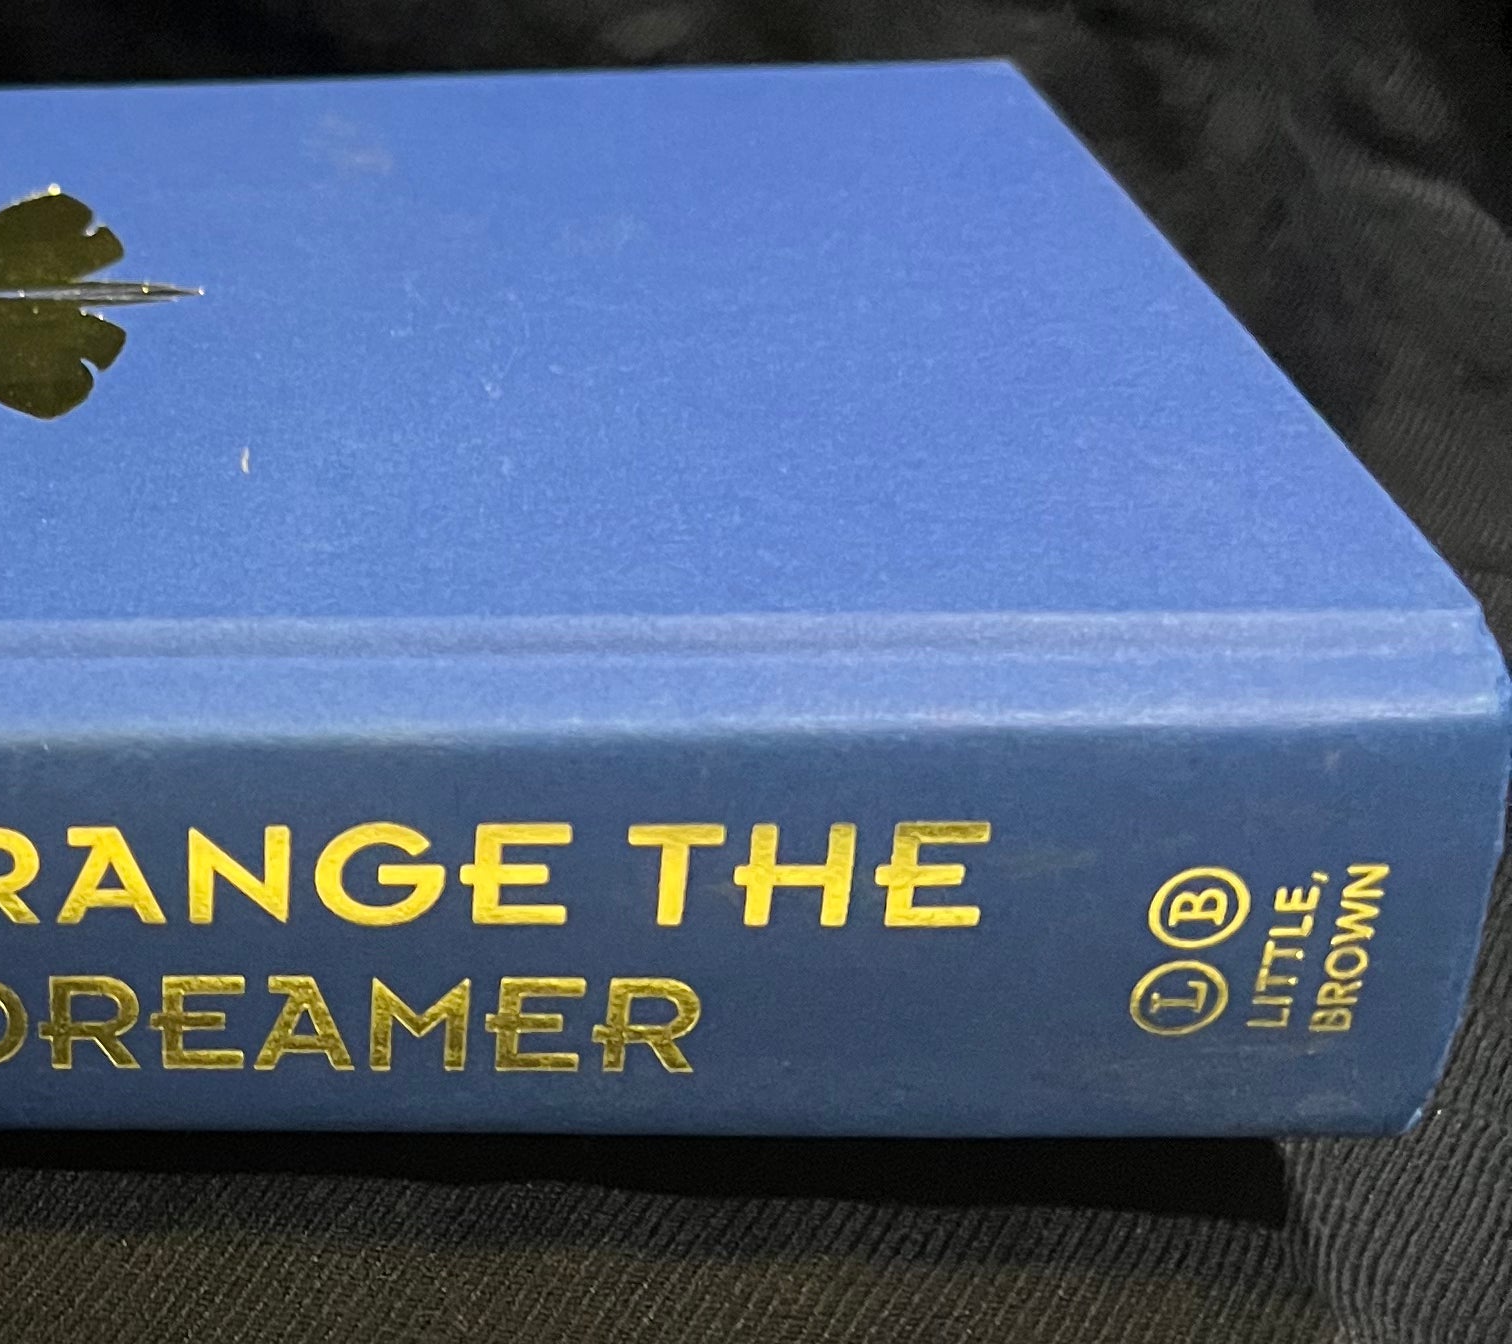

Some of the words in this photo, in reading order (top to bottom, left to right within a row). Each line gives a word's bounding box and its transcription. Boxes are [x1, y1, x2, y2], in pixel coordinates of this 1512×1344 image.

[627, 820, 993, 929] THE
[1245, 869, 1330, 1028] LITTLE,
[1308, 862, 1390, 1033] BROWN
